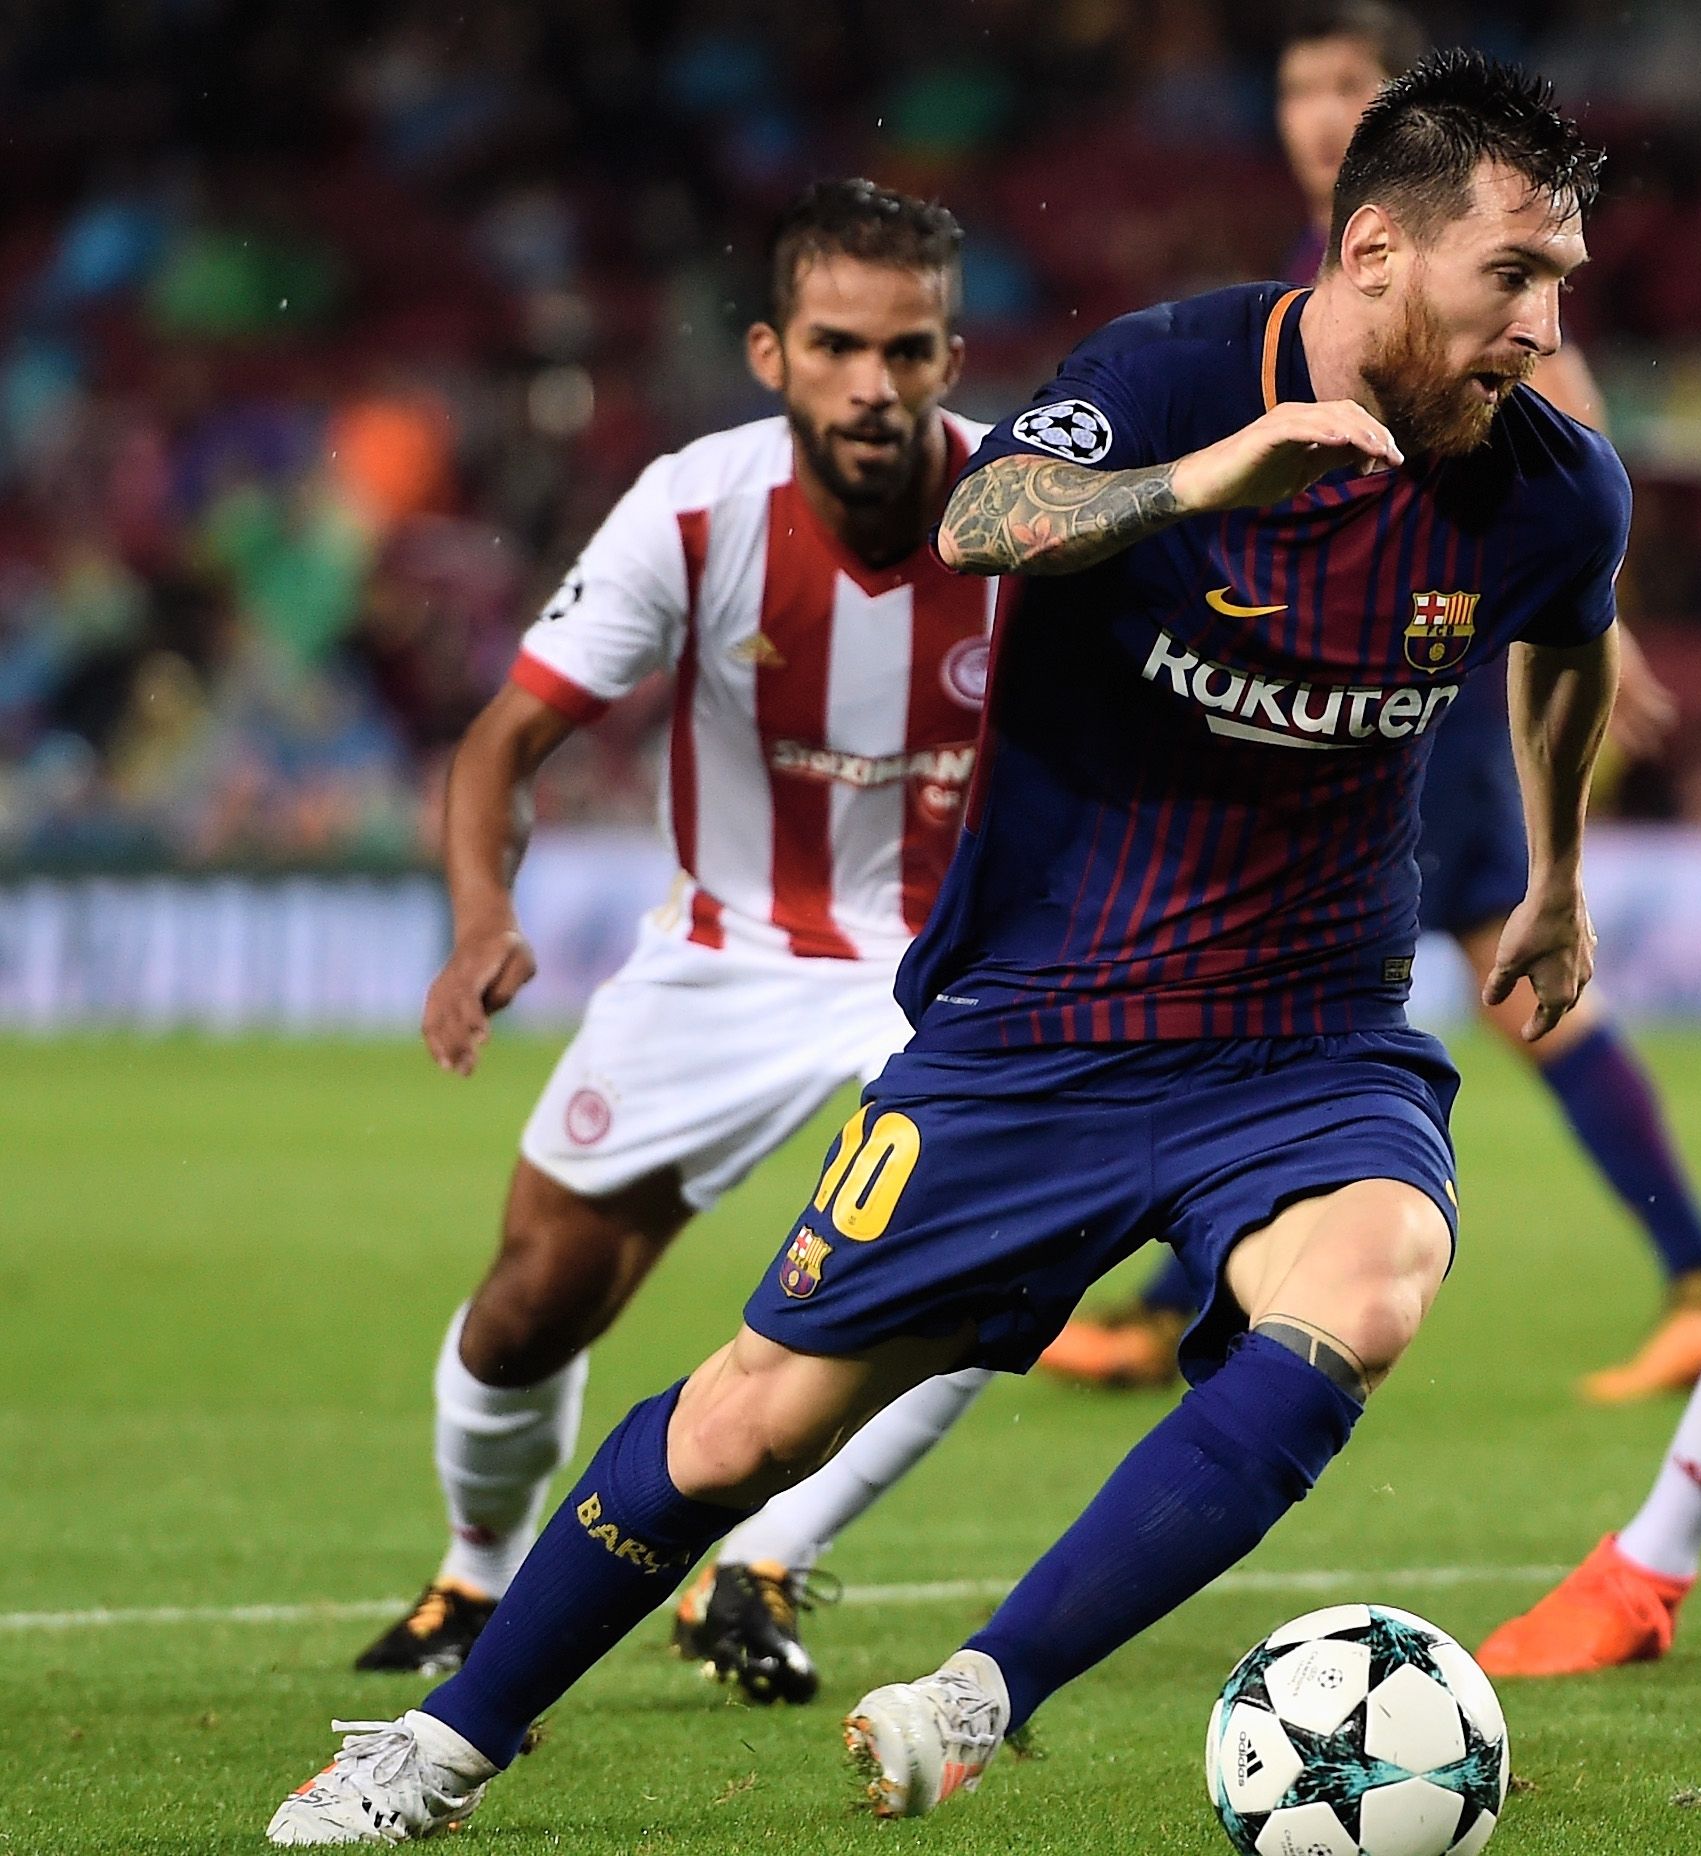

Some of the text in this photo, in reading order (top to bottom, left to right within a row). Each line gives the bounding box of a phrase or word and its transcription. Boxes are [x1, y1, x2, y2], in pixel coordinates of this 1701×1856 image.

[1141, 627, 1460, 740] Rakuten
[814, 1101, 921, 1242] 10
[1237, 1730, 1247, 1787] adidas
